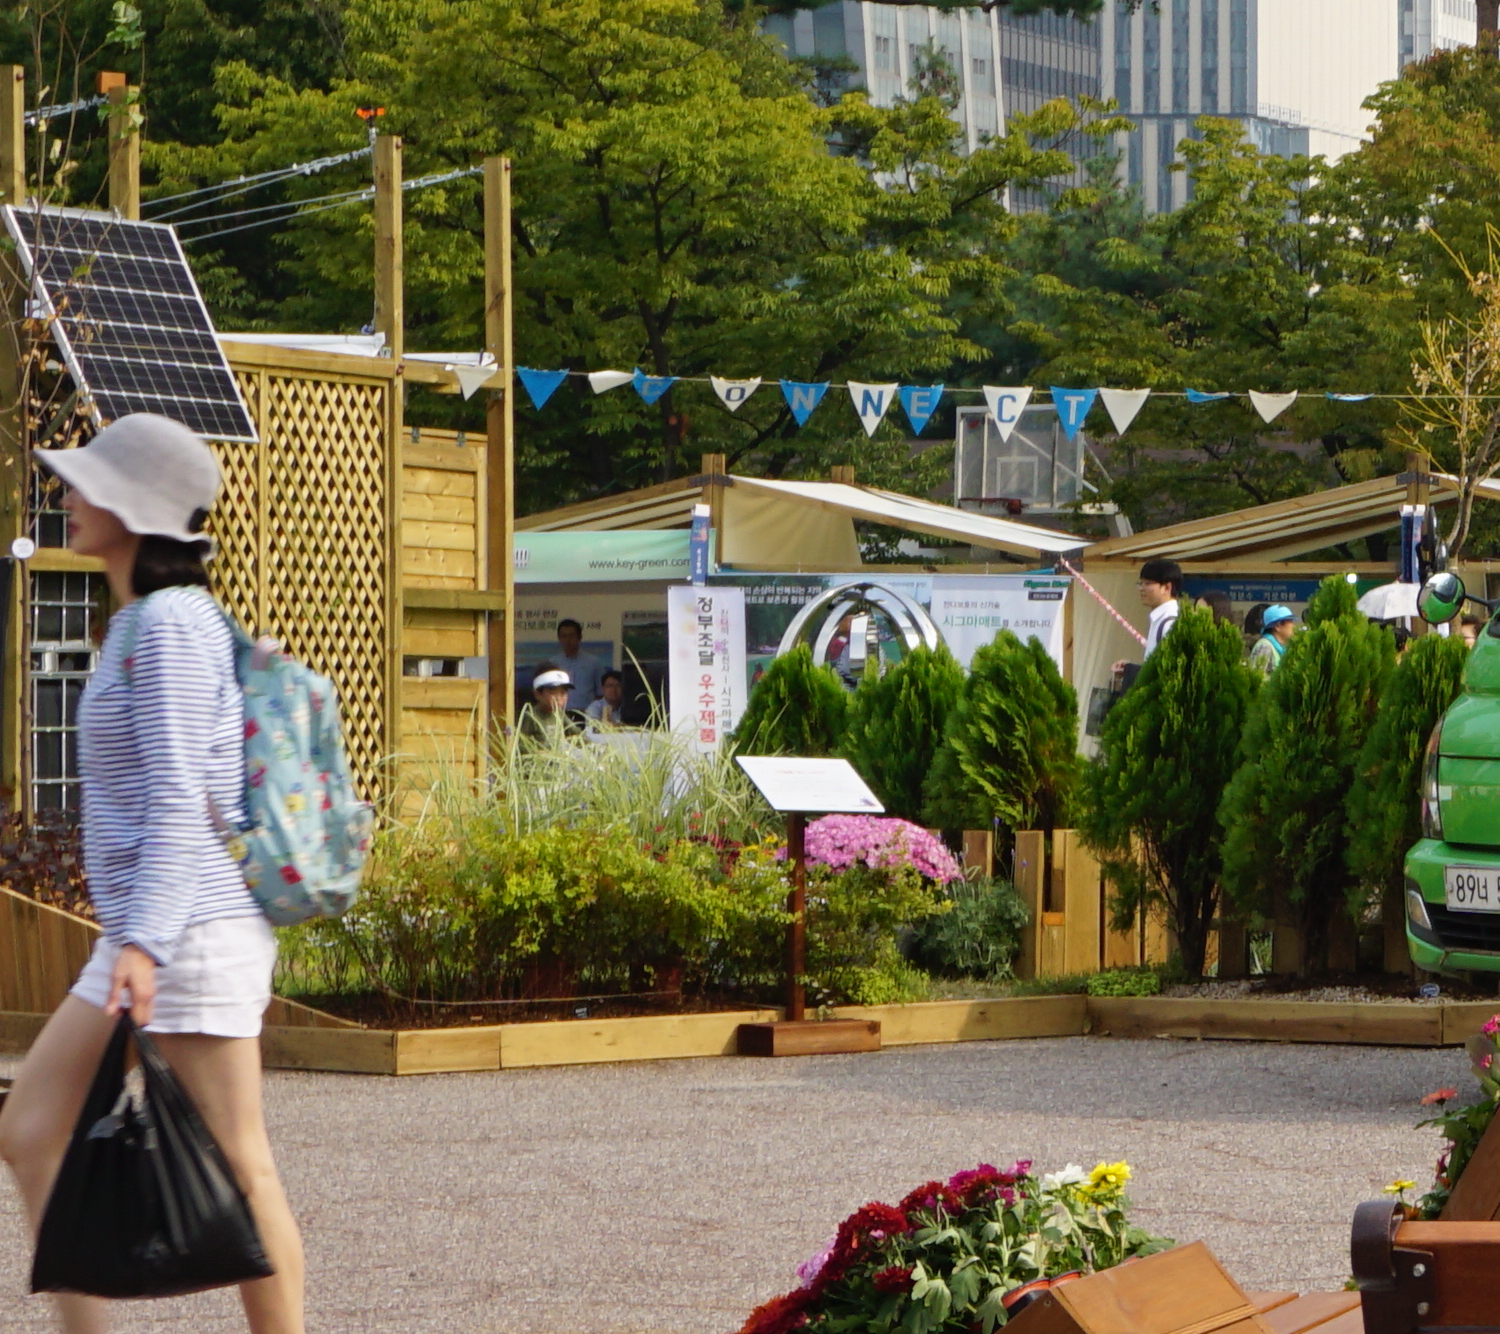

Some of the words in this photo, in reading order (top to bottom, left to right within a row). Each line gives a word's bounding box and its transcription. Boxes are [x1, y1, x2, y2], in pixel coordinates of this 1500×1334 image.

[697, 597, 715, 666] 정부조달
[720, 686, 732, 730] 시그마매
[1455, 874, 1489, 904] 89너
